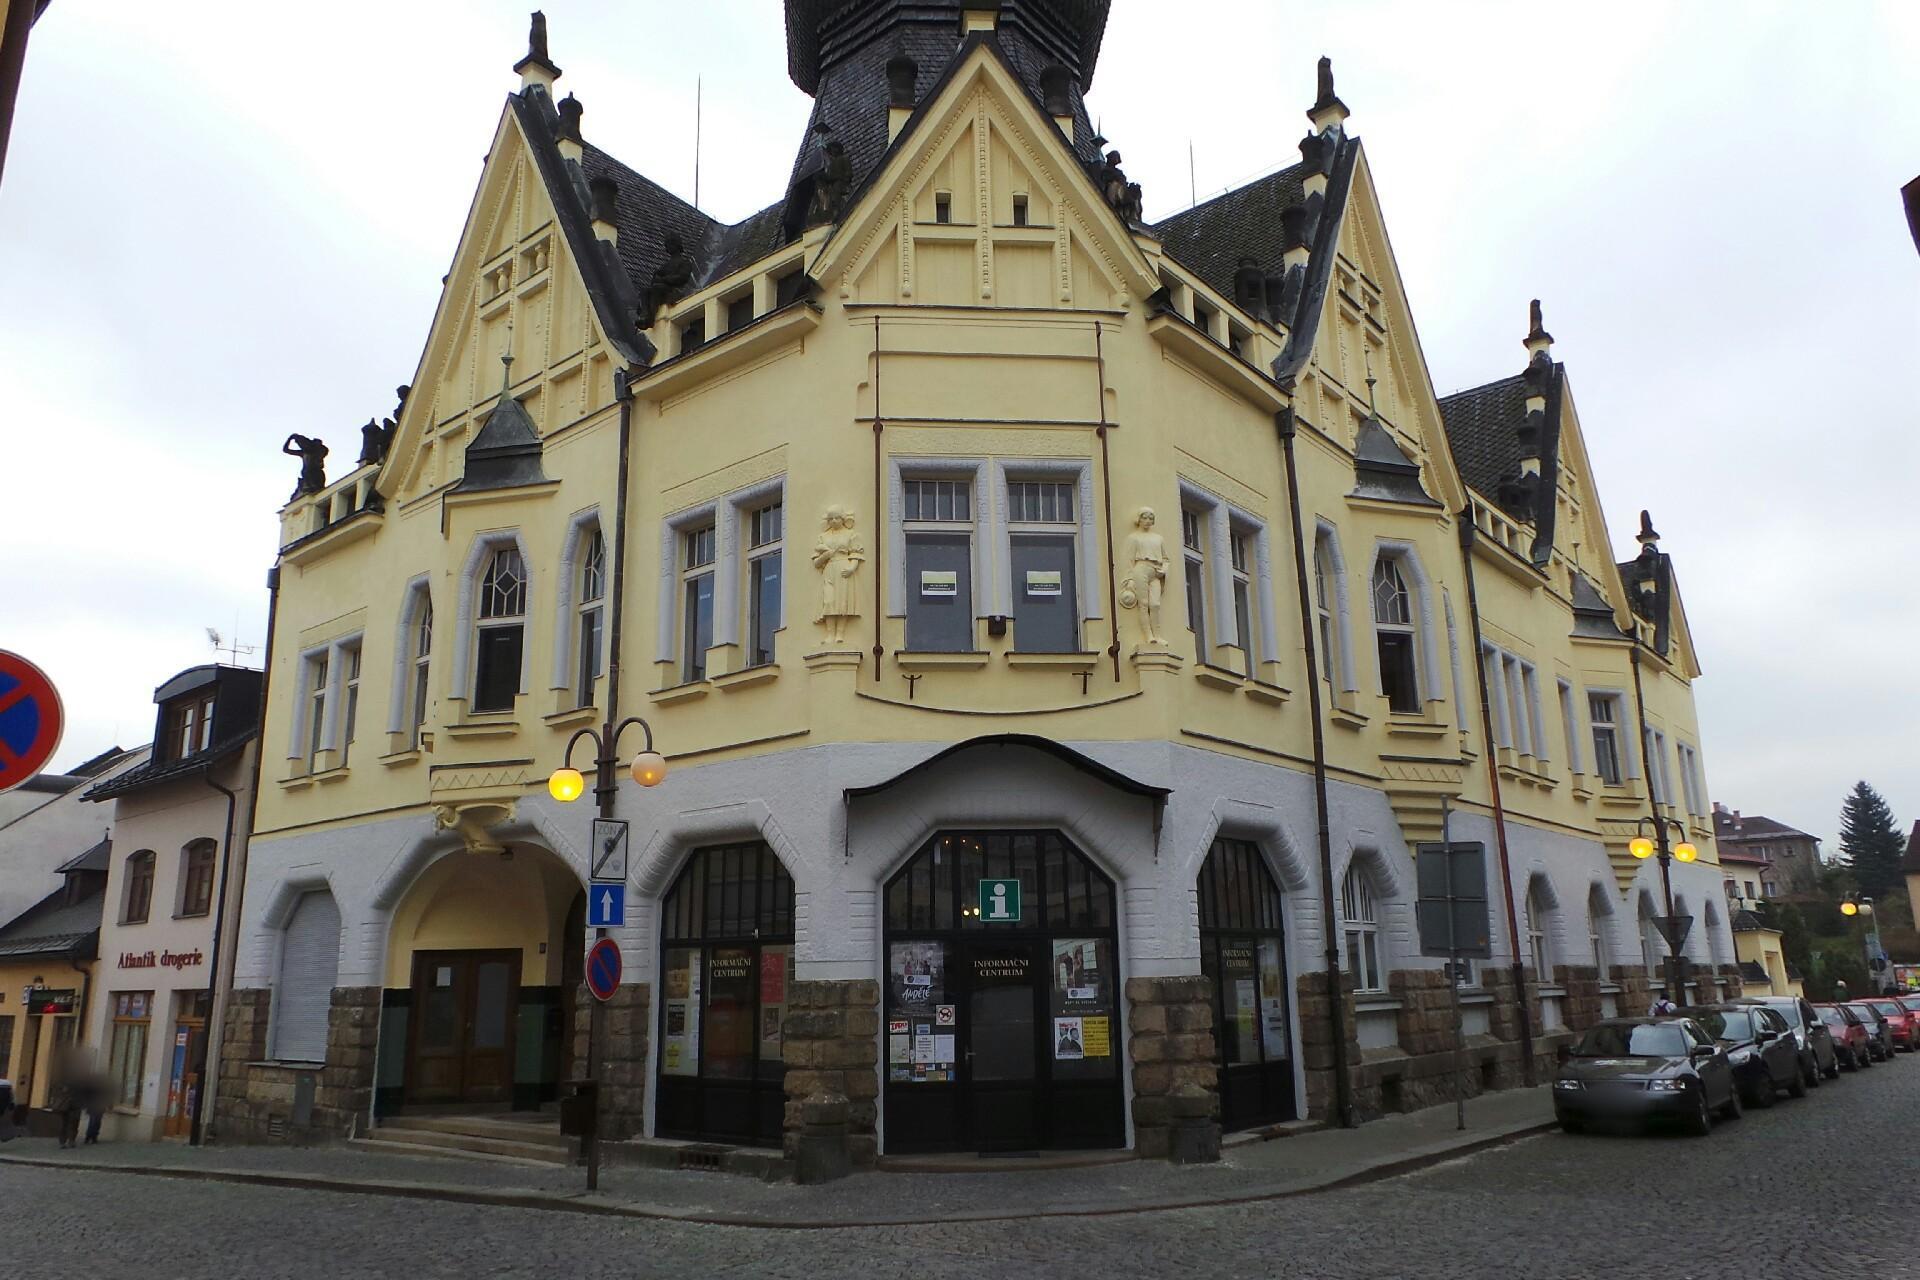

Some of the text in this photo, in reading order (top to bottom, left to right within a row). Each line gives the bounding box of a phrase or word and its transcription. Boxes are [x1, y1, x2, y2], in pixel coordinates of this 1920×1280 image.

[118, 948, 202, 970] Atlantik drogerie
[713, 968, 747, 978] CENTRUM
[980, 968, 1023, 977] CENTRUM
